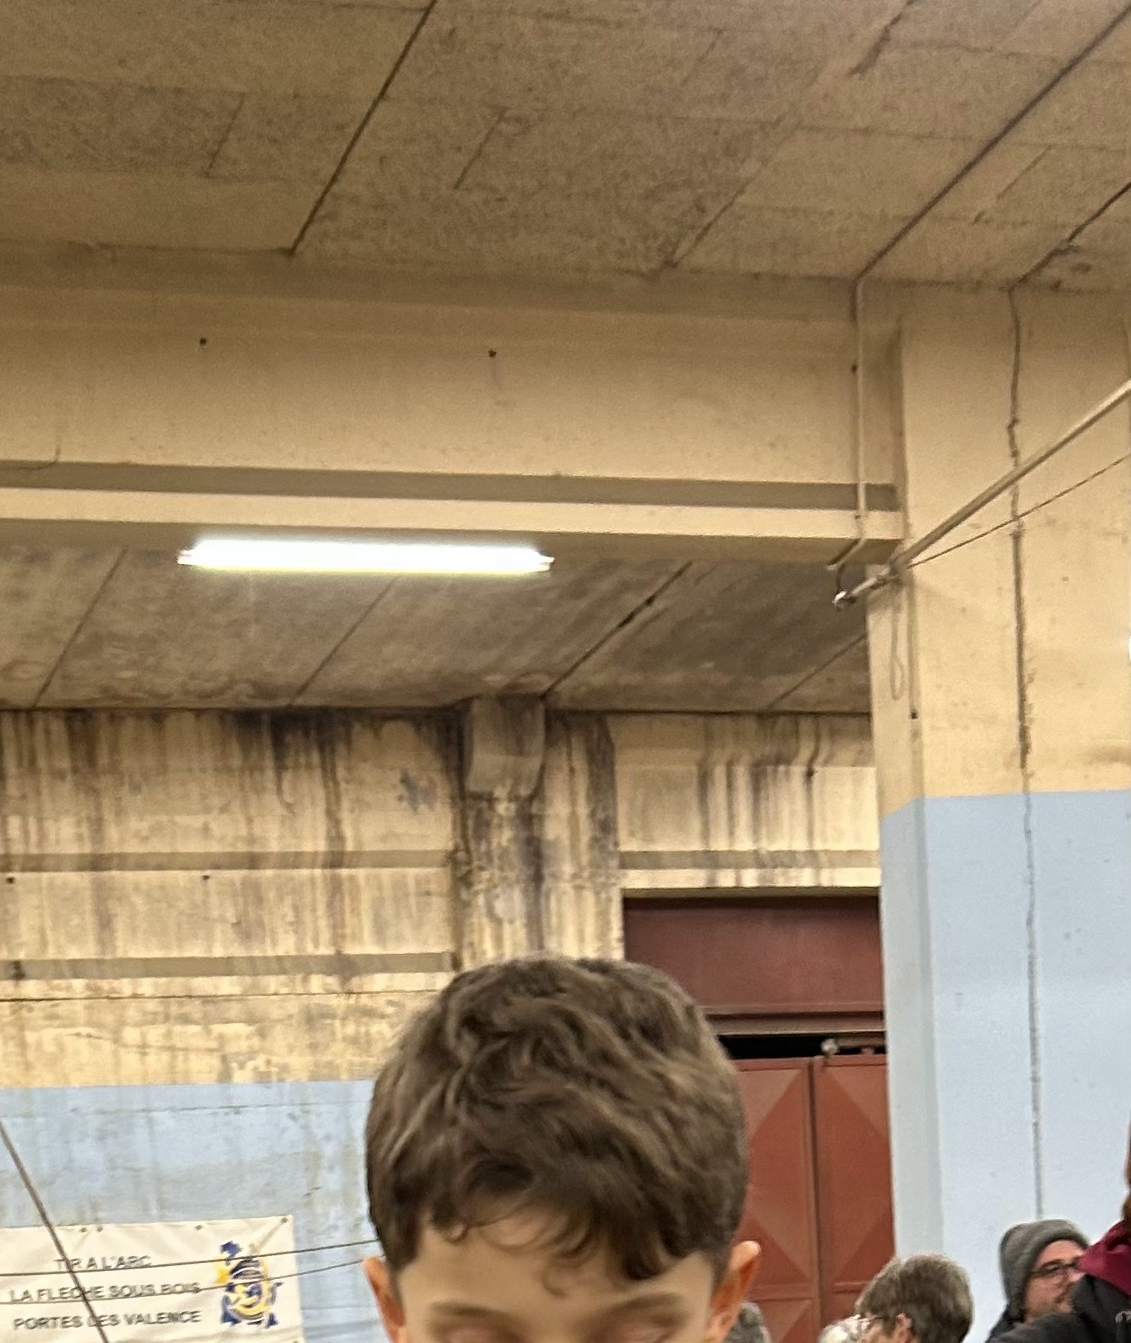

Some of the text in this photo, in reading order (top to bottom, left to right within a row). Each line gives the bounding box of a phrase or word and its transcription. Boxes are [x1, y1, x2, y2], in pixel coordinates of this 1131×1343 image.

[53, 1257, 82, 1270] TR
[9, 1289, 33, 1303] LA
[109, 1284, 155, 1299] SOUS
[13, 1315, 84, 1331] PORTES
[123, 1310, 202, 1326] VALENCE
